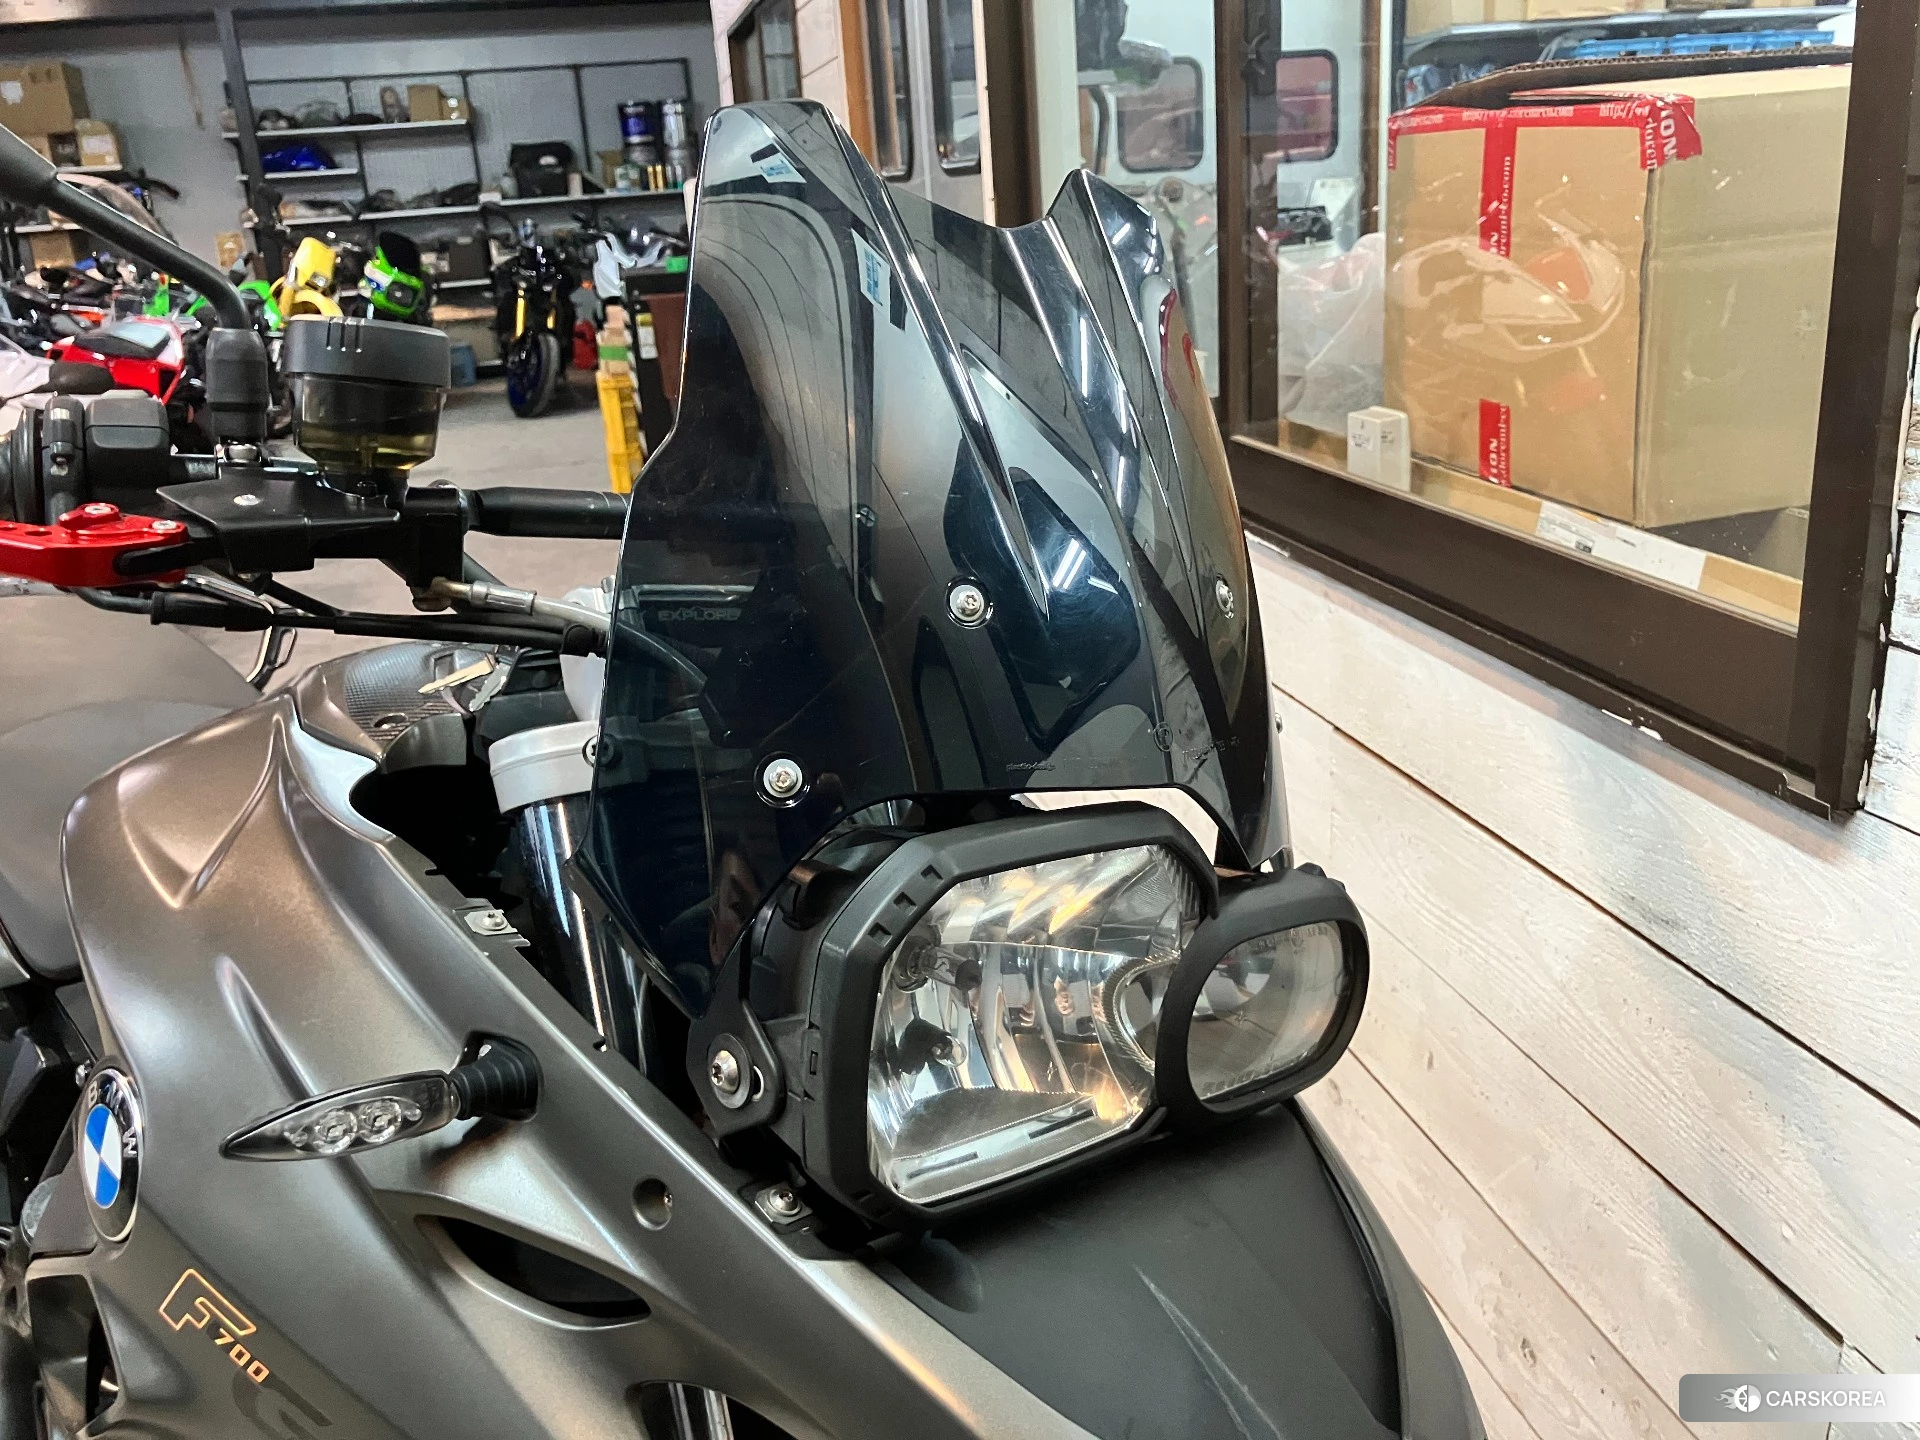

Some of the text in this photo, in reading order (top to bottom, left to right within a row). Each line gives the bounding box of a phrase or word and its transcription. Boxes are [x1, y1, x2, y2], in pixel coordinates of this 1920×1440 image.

[87, 1079, 139, 1159] BMW
[159, 1268, 270, 1383] F 700
